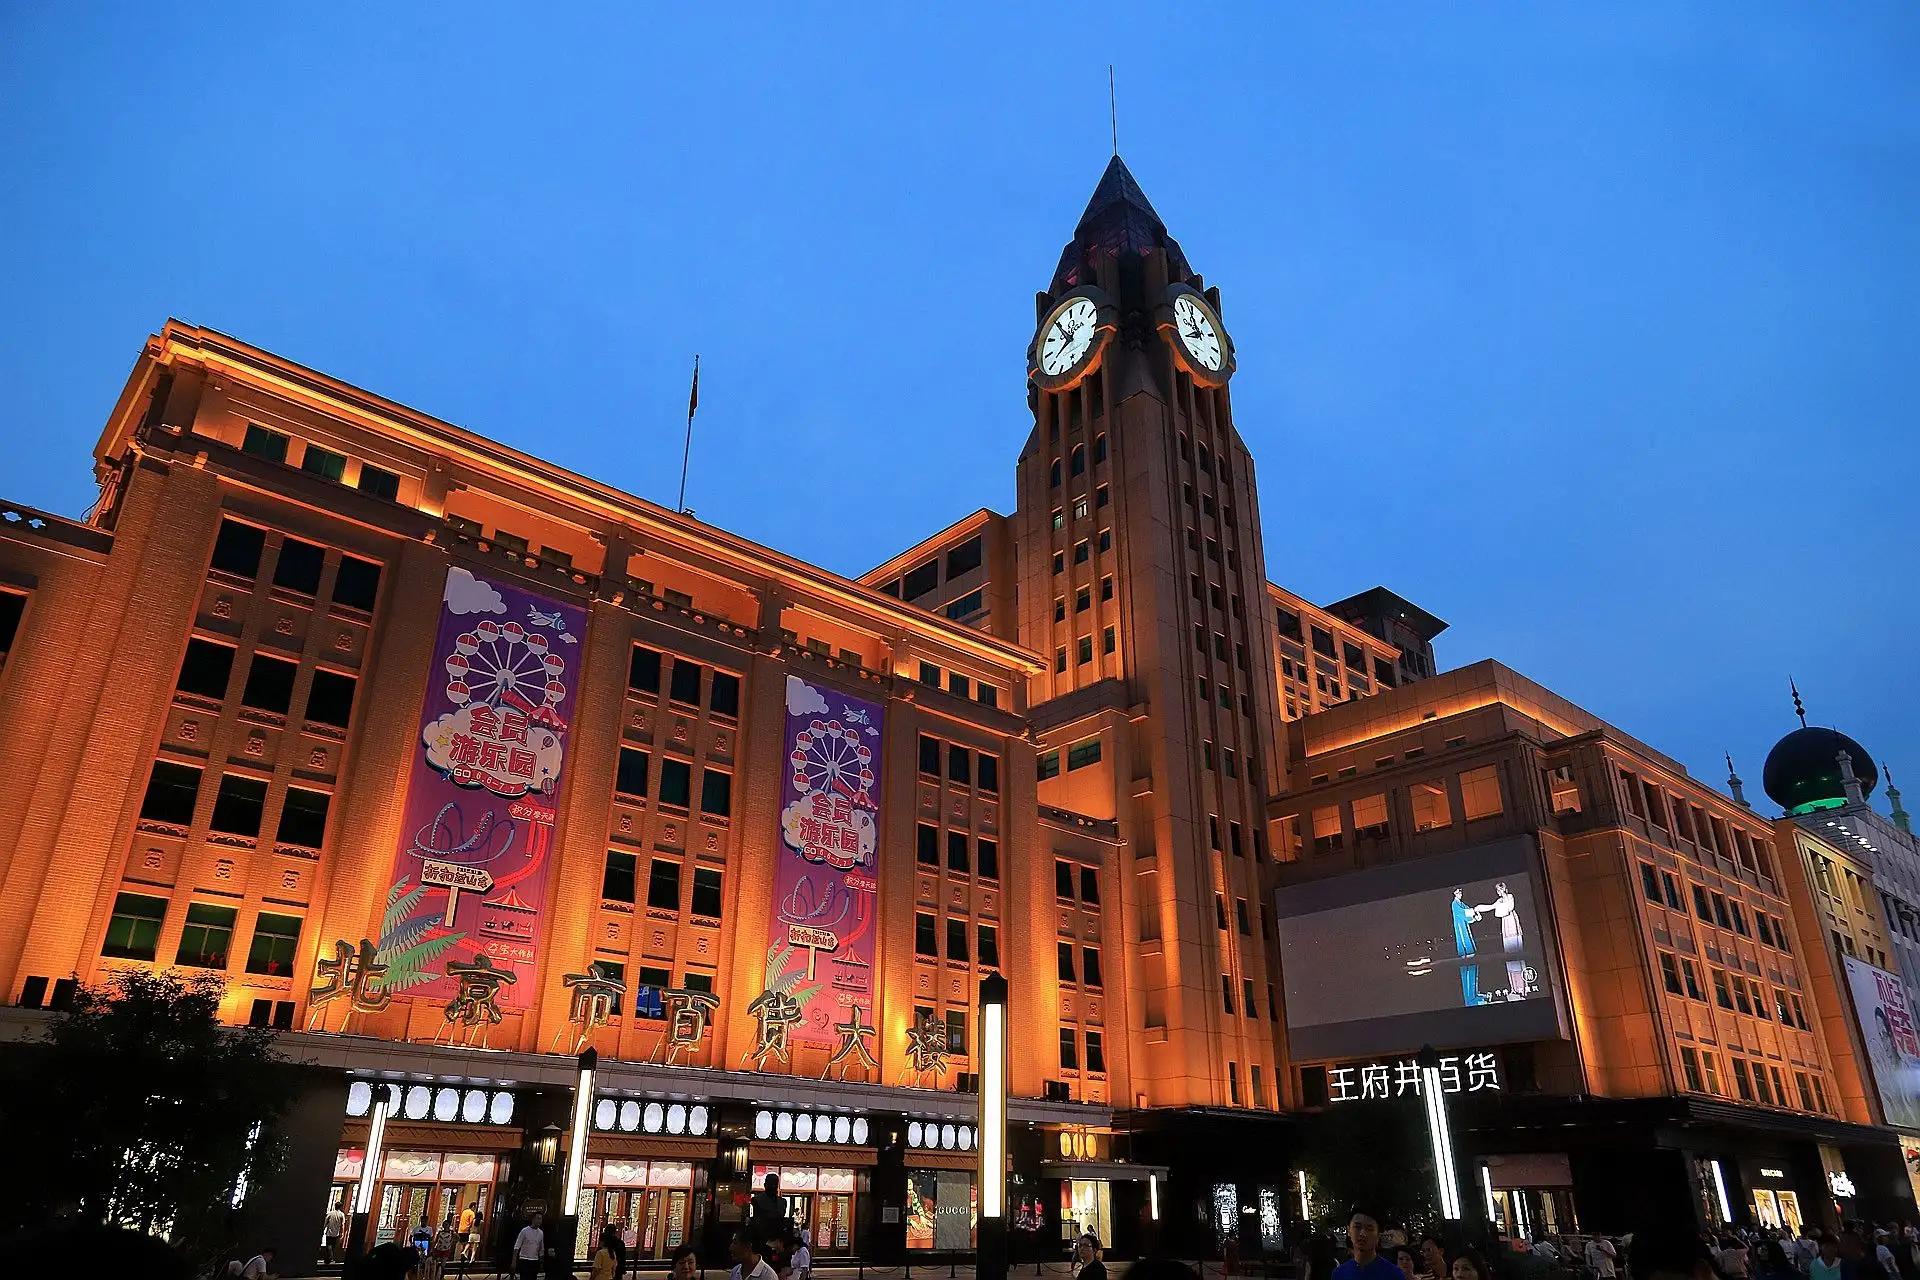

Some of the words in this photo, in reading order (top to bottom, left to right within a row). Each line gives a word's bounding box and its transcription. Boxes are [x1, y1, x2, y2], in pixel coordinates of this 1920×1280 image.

[469, 705, 530, 747] 会员
[448, 732, 538, 780] 游乐园
[453, 768, 472, 779] GO
[811, 792, 854, 828] 会员
[799, 816, 859, 855] 游乐园
[804, 846, 818, 855] GO
[423, 863, 490, 889] 折扣过山车
[487, 942, 535, 959] 夺宝大作战
[789, 927, 837, 949] 折扣过山车
[1328, 1053, 1501, 1102] 王府井百货
[938, 1206, 969, 1216] GUCCI
